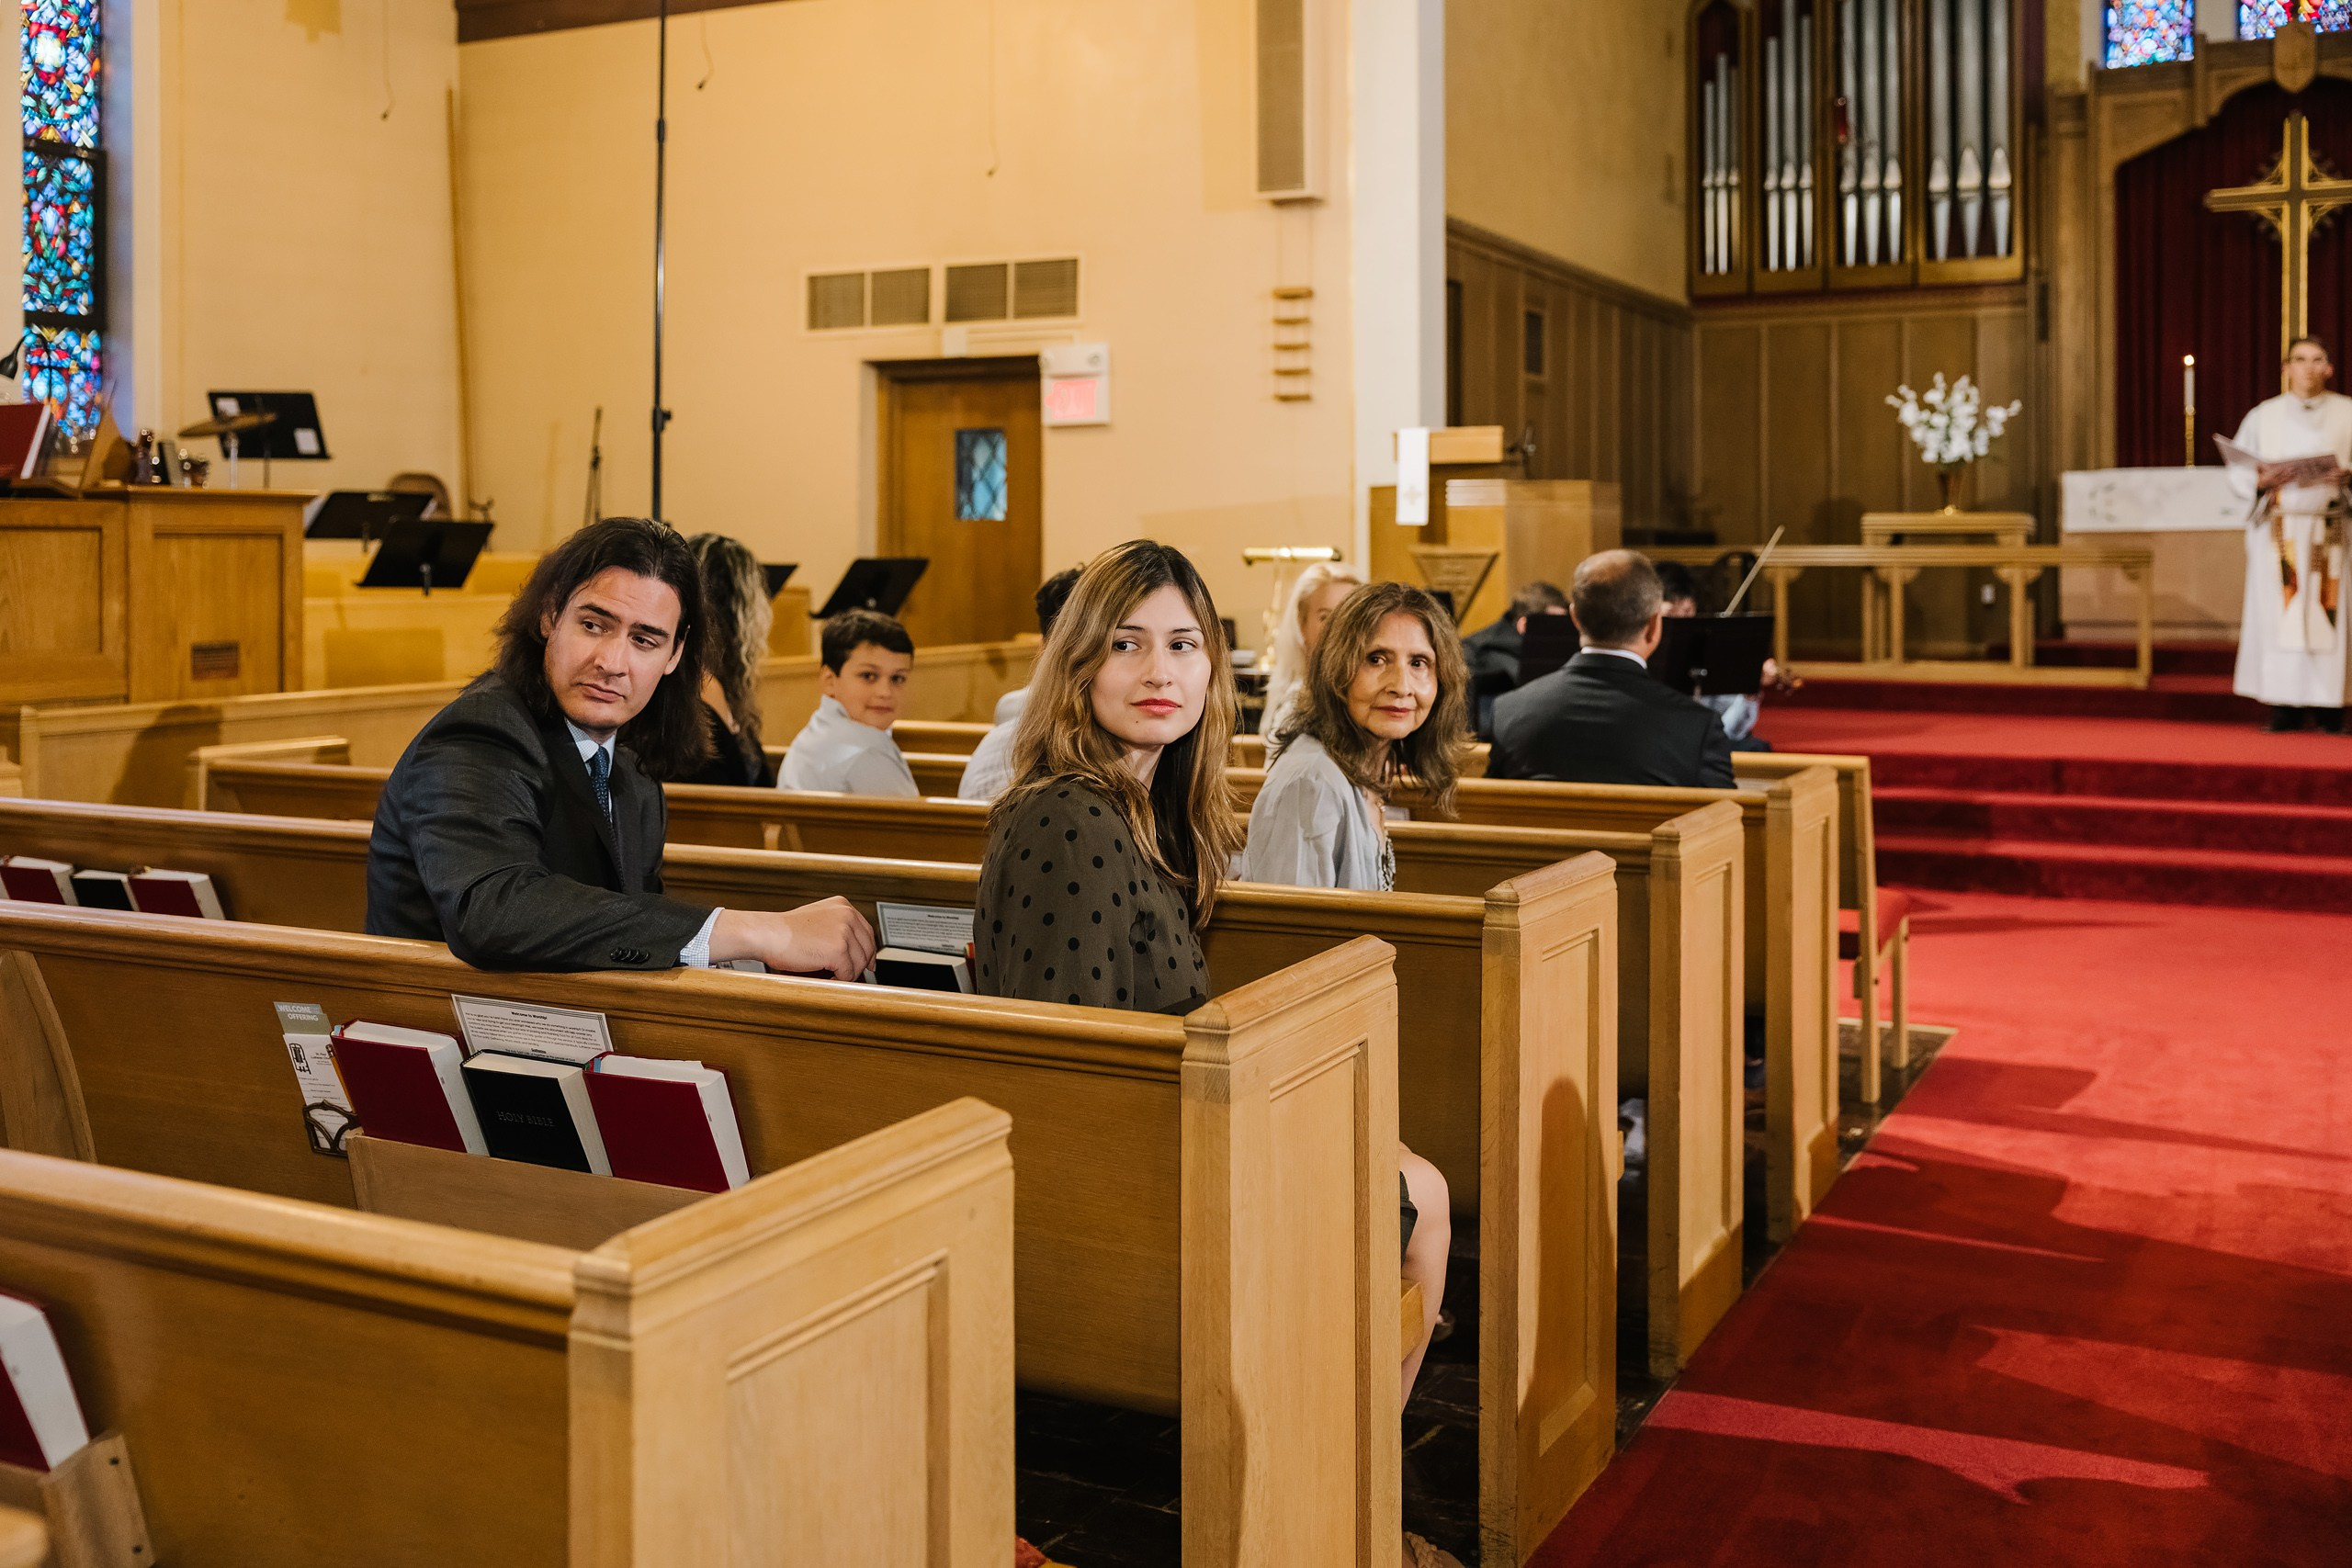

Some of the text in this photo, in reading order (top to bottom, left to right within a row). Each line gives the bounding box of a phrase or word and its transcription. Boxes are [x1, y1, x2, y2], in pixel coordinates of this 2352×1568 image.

[277, 1004, 311, 1013] WELCOME
[288, 1013, 319, 1021] OFFERING
[495, 1110, 555, 1127] HOLY BIBLE
